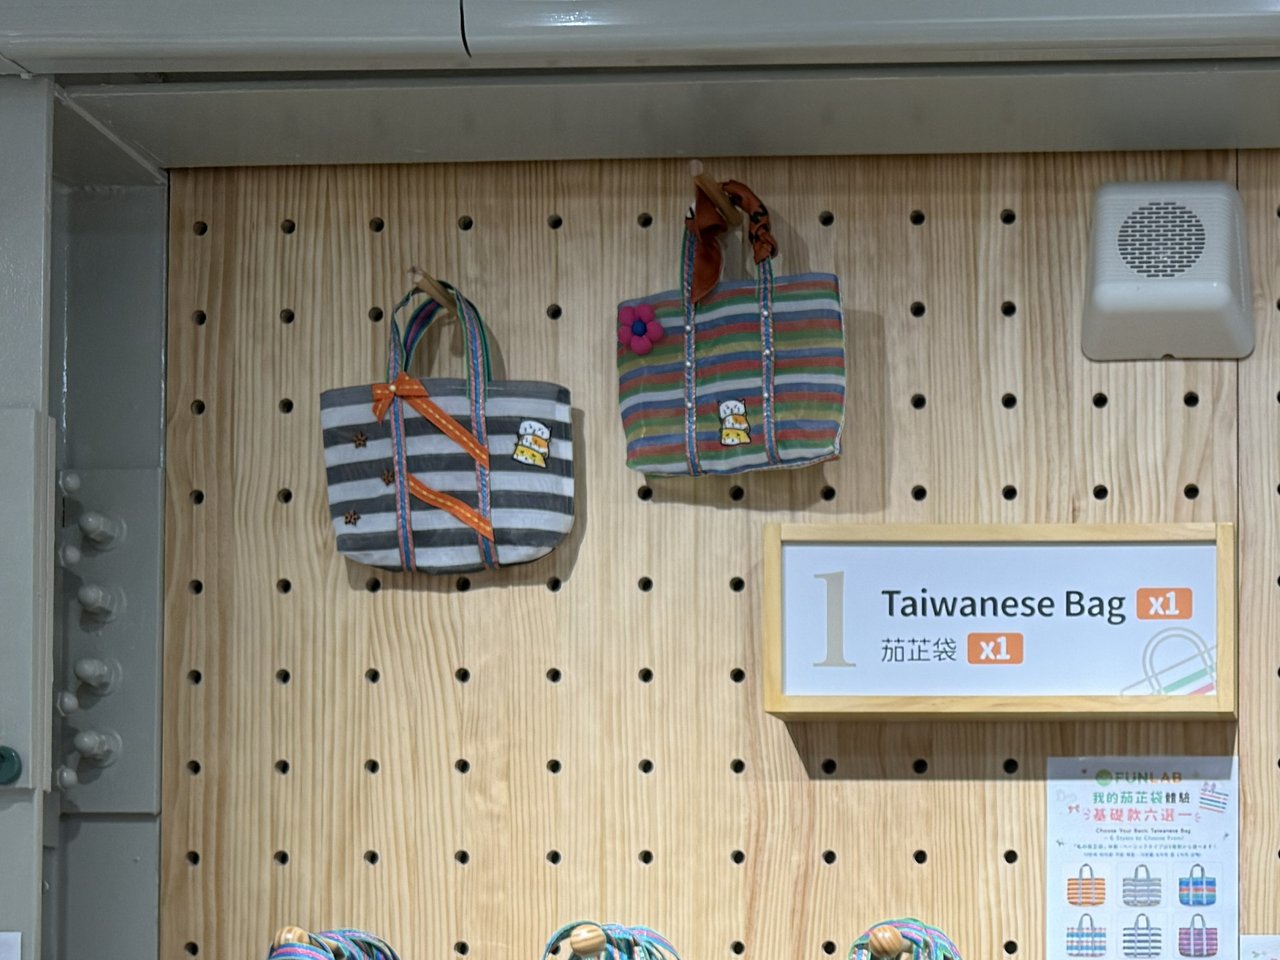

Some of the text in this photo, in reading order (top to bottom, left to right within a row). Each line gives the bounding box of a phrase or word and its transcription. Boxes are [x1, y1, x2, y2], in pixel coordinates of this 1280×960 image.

[813, 571, 857, 668] 1
[881, 588, 1180, 625] Taiwanese Bag x1
[881, 636, 1011, 663] 茄芷袋 x1
[1114, 771, 1183, 784] FUNLAB
[1093, 808, 1193, 822] 基礎款六選一
